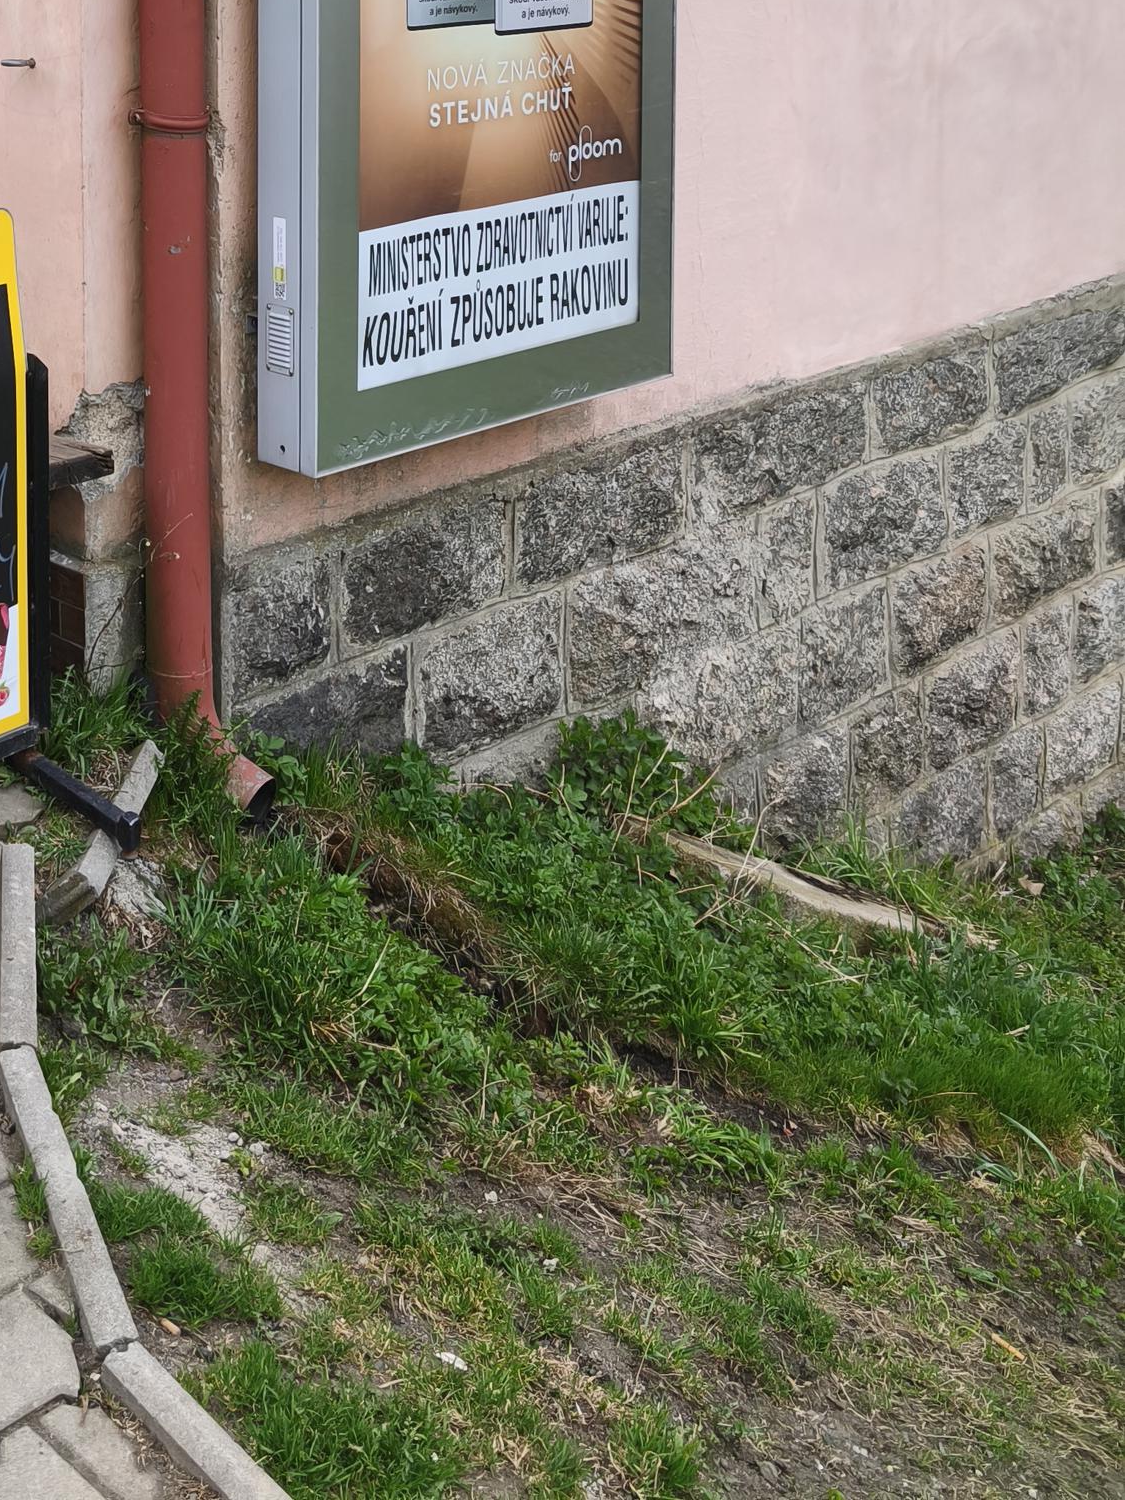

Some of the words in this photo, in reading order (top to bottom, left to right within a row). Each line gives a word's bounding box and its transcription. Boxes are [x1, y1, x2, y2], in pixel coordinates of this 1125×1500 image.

[429, 8, 435, 16] a
[435, 6, 443, 18] je
[443, 2, 478, 16] návykový.
[521, 10, 527, 19] a
[527, 8, 536, 21] je
[536, 4, 571, 19] návykový.
[426, 57, 490, 93] NOVÁ
[497, 51, 577, 85] ZNAČKA
[429, 93, 515, 128] STEJNÁ
[522, 85, 574, 116] CHUŤ
[549, 148, 563, 164] for
[567, 125, 623, 182] ploom
[368, 222, 472, 299] MINISTERSTVO
[475, 193, 576, 274] ZDRAVOTNICTVÍ
[577, 194, 630, 252] VARUJE:
[362, 287, 444, 369] KOUŘENÍ
[450, 277, 545, 349] ZPŮSOBUJE
[550, 257, 630, 323] RAKOVINU
